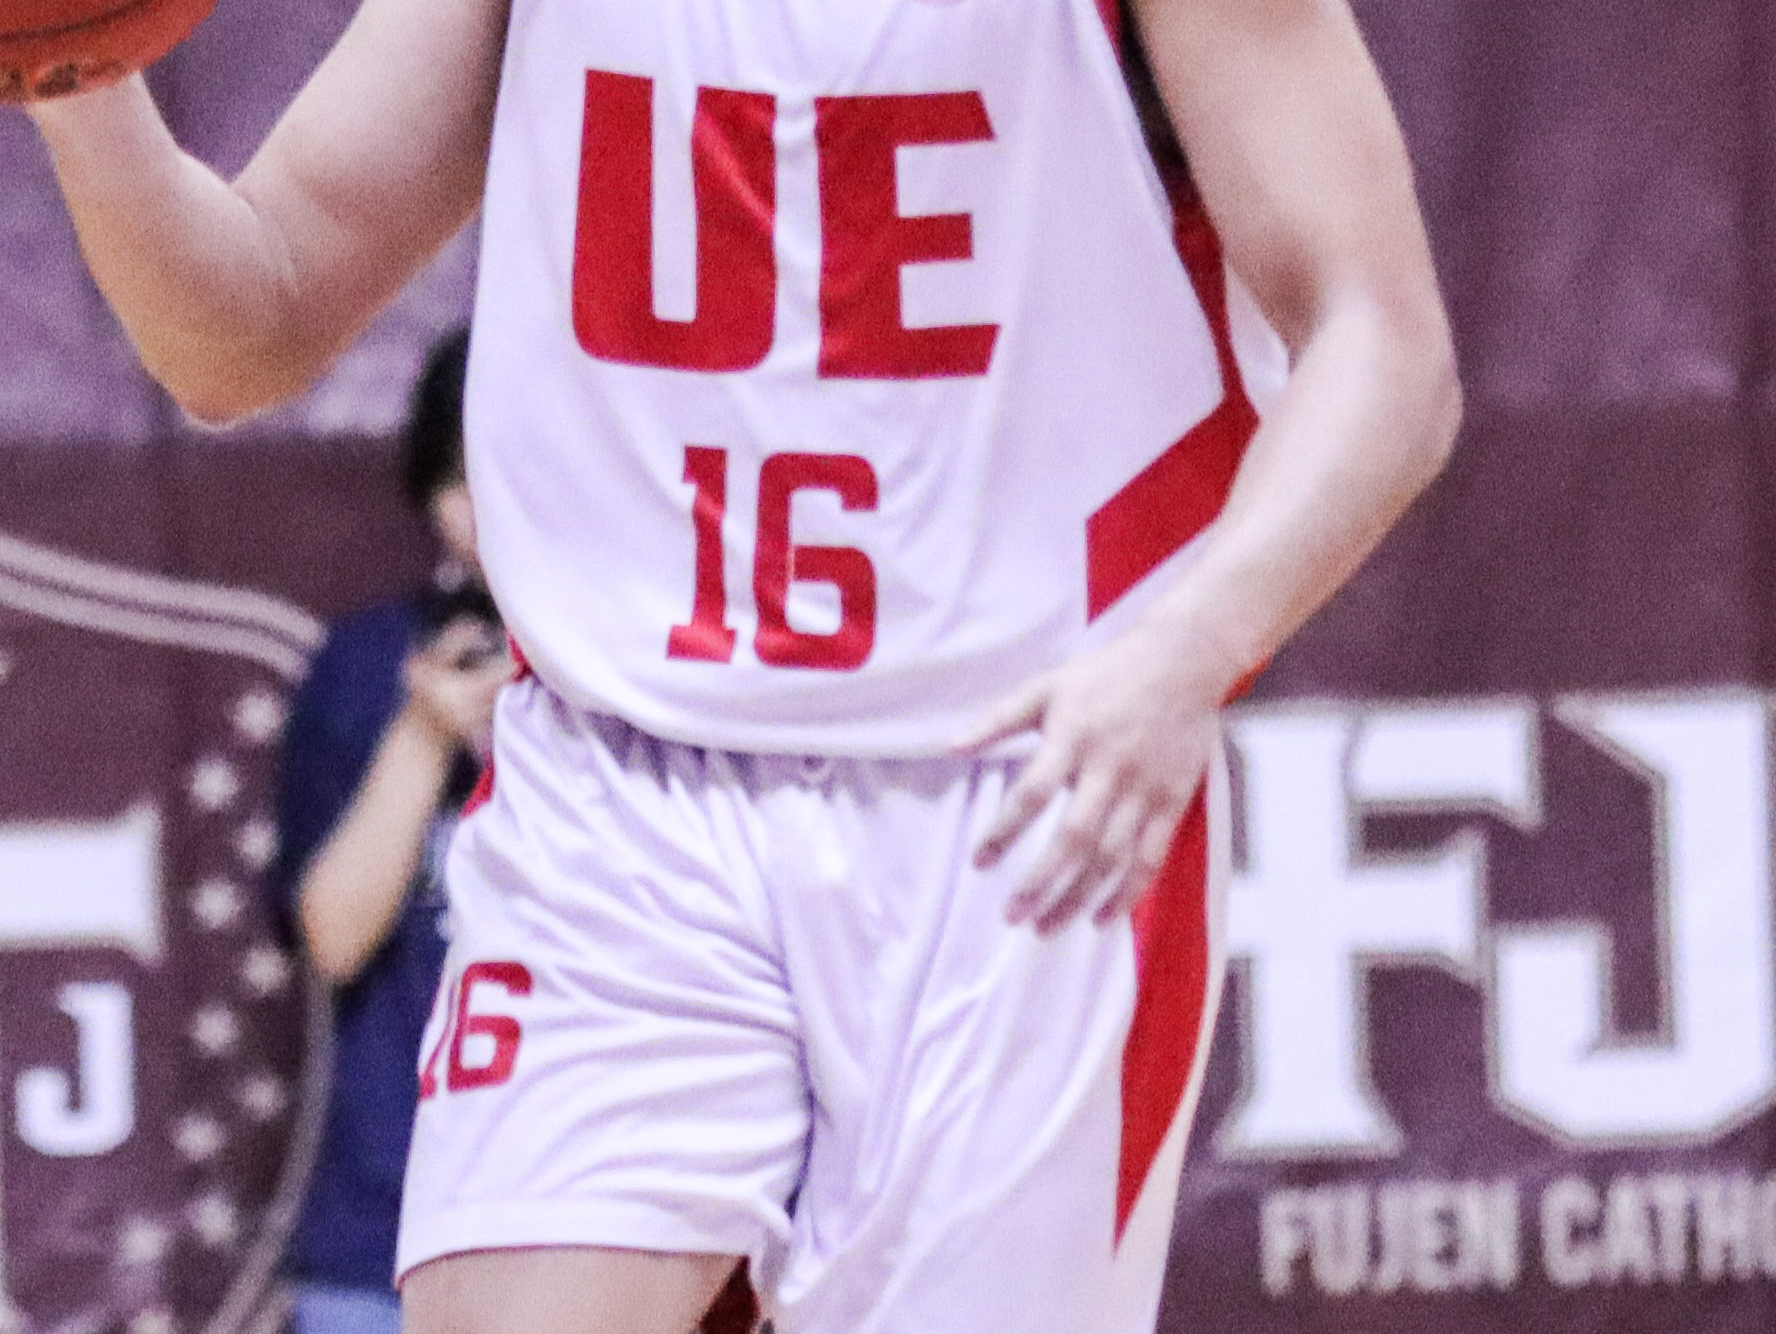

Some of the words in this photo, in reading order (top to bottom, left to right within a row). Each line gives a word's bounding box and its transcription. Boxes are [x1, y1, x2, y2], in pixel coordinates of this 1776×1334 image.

[571, 69, 1000, 379] UE
[666, 445, 880, 672] 16
[16, 981, 138, 1159] J
[1260, 1175, 1521, 1297] FUJEN
